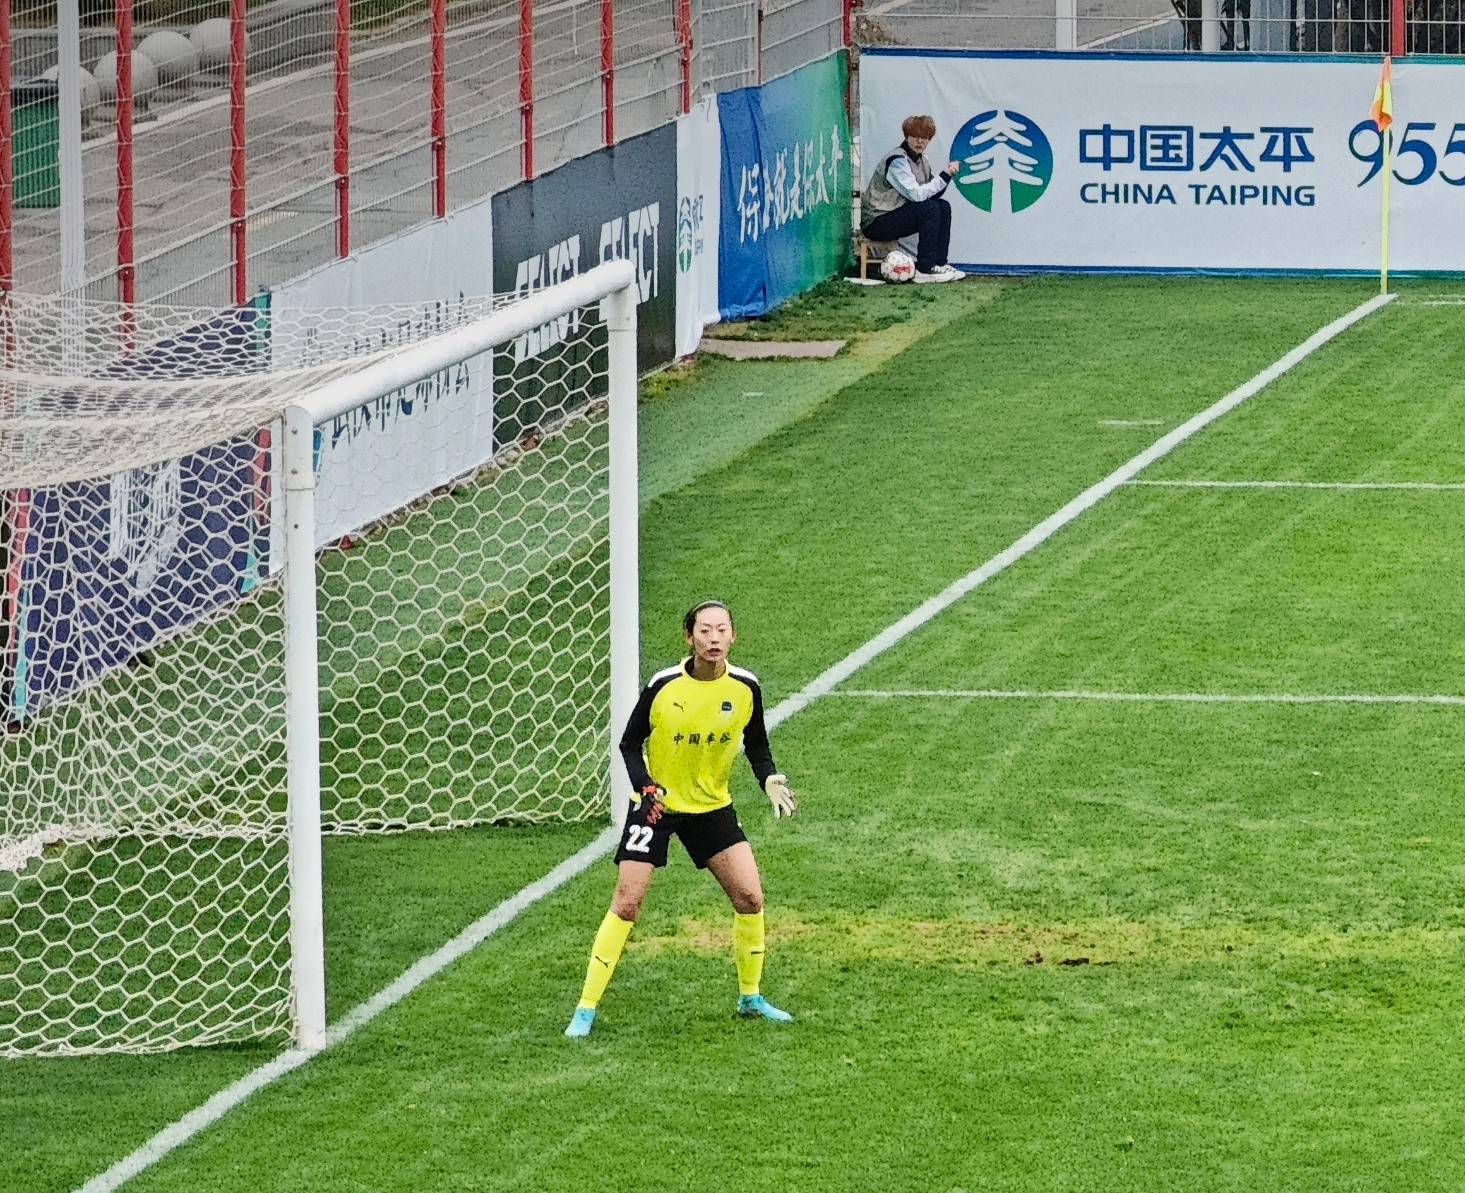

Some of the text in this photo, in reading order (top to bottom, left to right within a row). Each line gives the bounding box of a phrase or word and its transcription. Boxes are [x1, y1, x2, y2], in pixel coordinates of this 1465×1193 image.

[1080, 124, 1315, 173] 中国太平
[1080, 183, 1315, 207] CHINA TAIPING
[626, 824, 654, 853] 22
